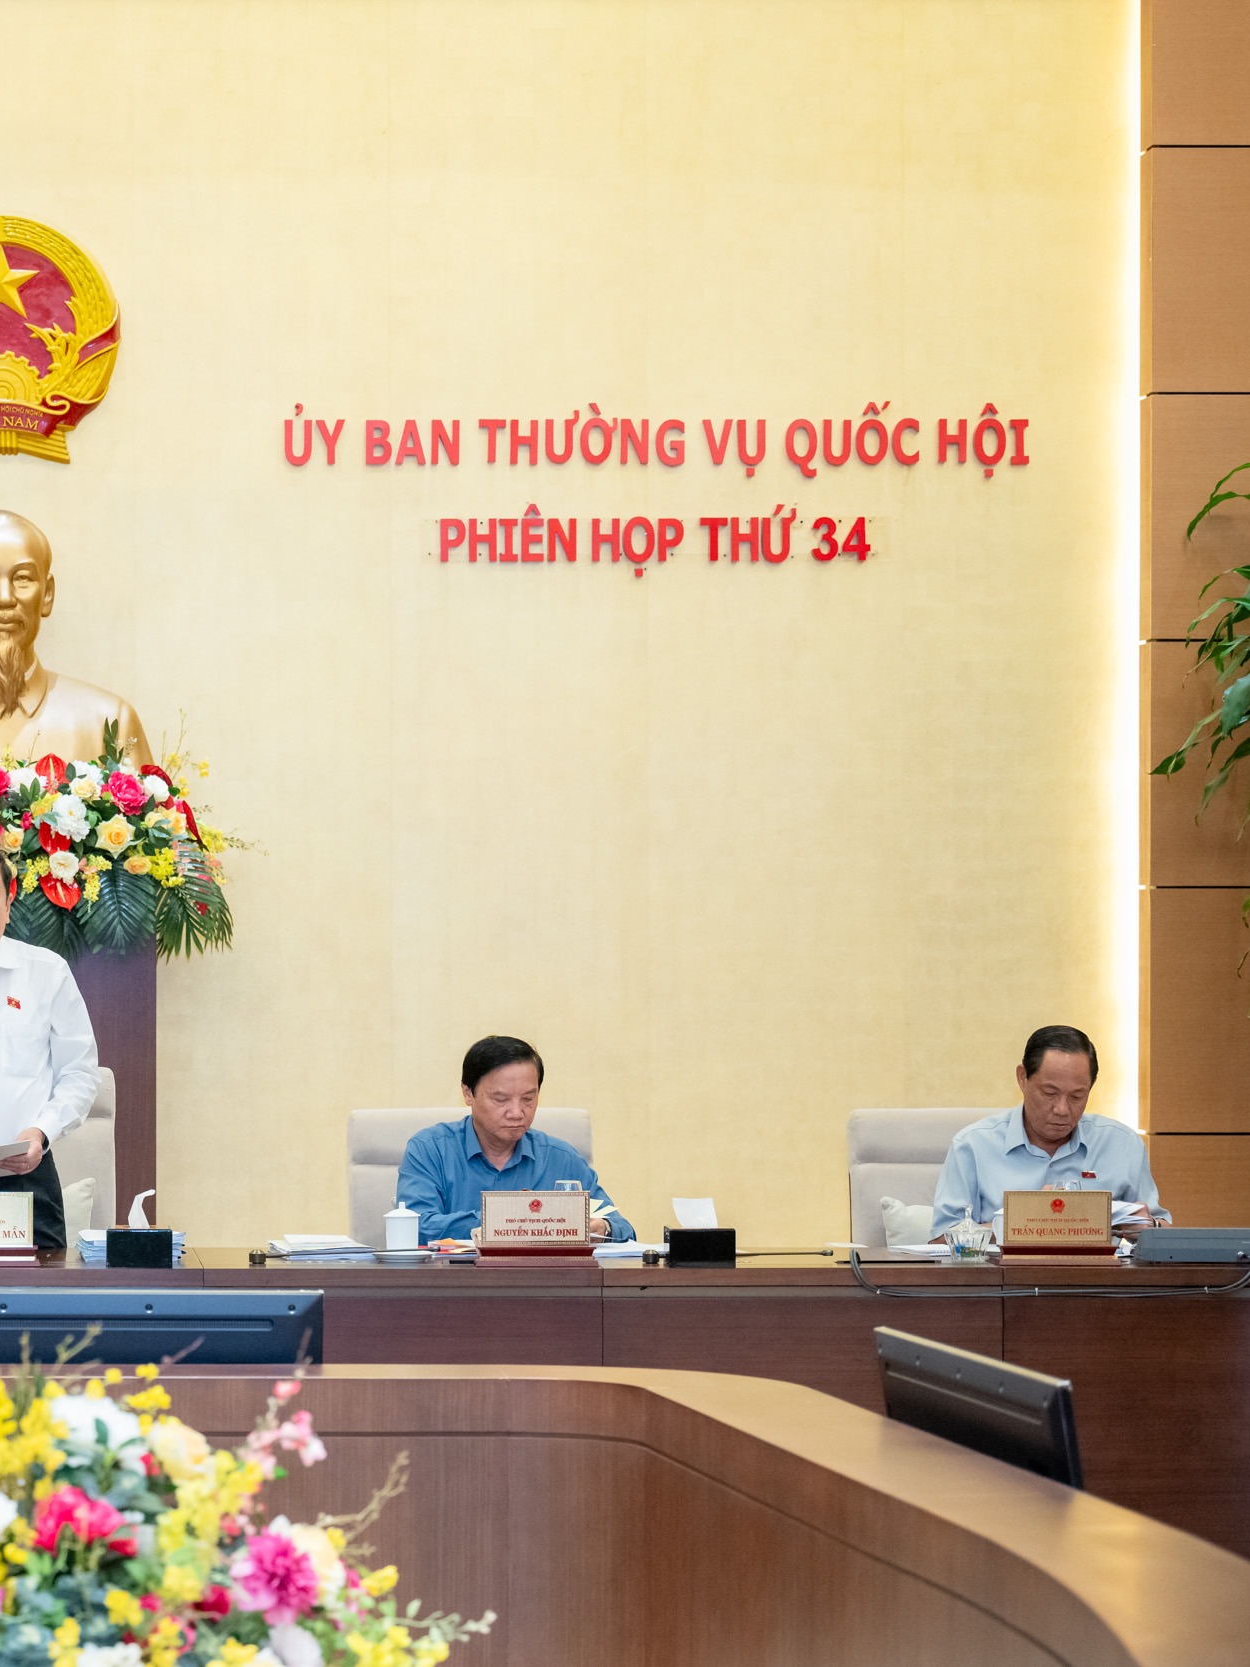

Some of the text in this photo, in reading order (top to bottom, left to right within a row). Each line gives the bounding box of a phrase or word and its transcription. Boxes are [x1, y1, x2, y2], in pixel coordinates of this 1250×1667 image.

[2, 415, 40, 431] NAM
[284, 401, 1030, 478] ỦY BAN THƯỜNG VỤ QUỐC HỘI
[440, 504, 871, 577] PHIÊN HỌP THỨ 34
[494, 1226, 529, 1237] NGUYỄN
[556, 1229, 578, 1238] ĐỊNH
[1036, 1228, 1066, 1237] QUANG
[1068, 1227, 1104, 1236] PHƯƠNG
